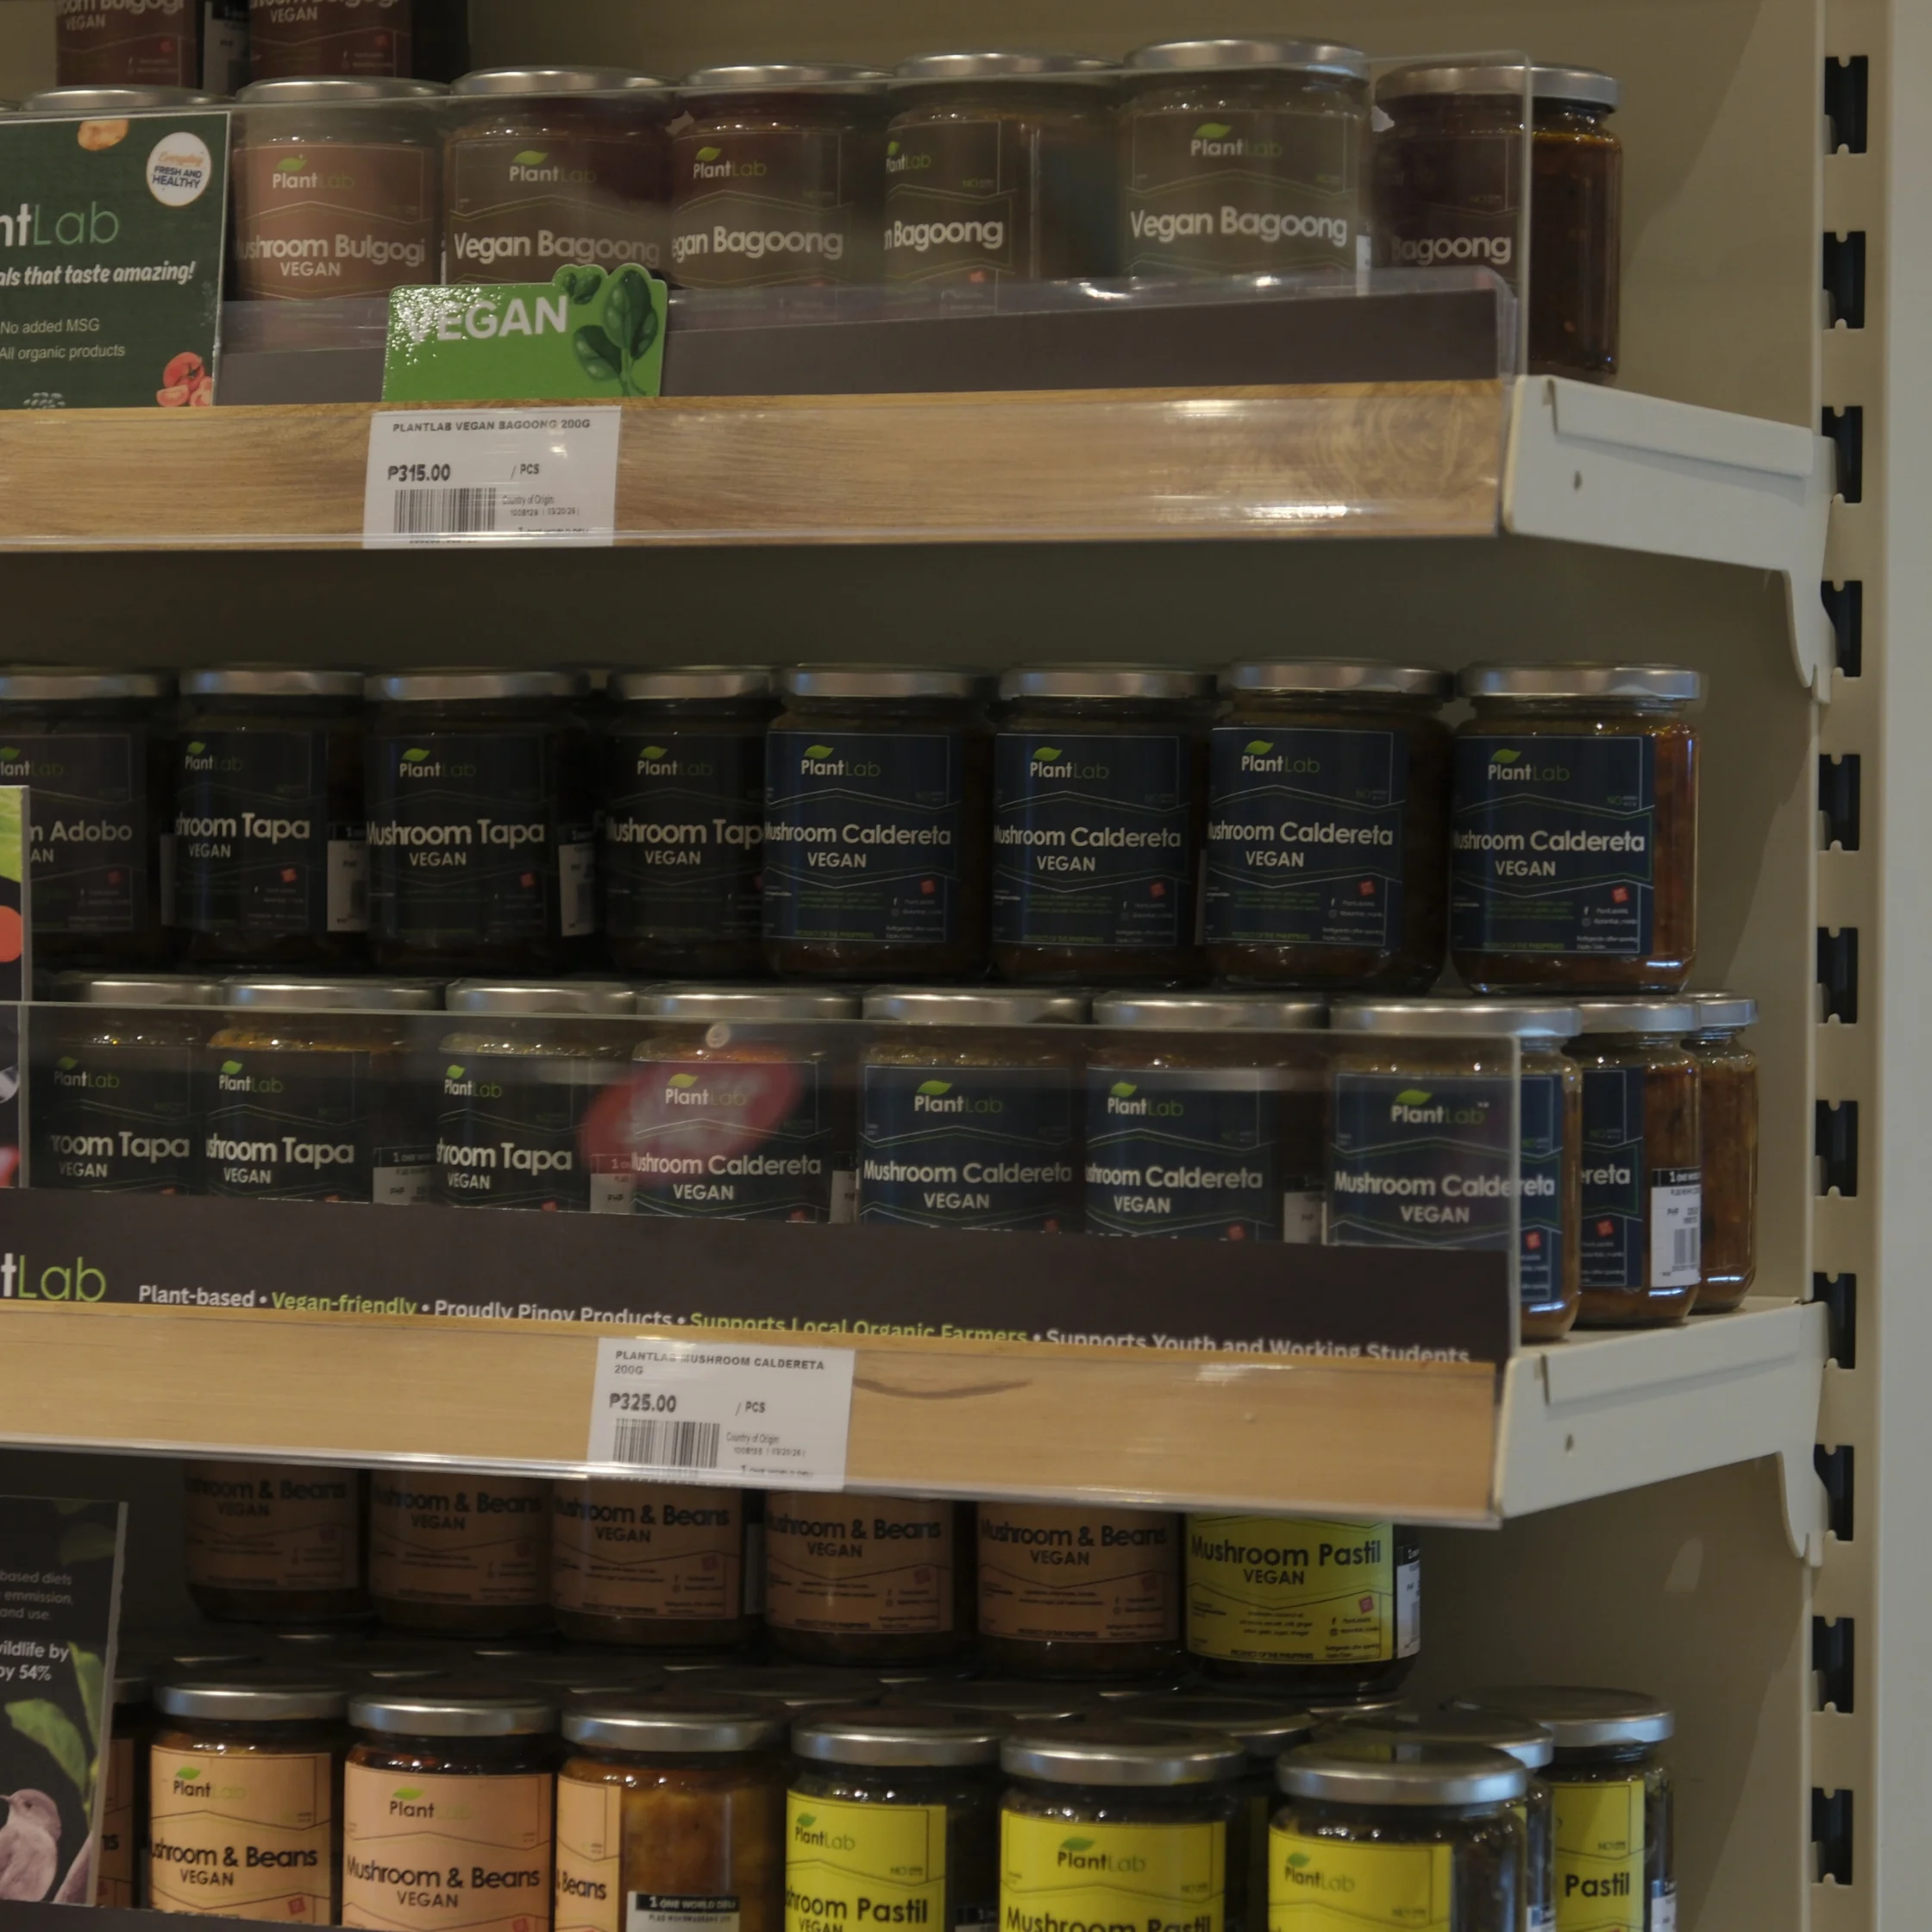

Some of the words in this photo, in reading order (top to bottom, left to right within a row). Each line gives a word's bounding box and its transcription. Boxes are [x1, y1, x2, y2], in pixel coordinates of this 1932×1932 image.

[66, 15, 105, 30] VEGAN
[270, 7, 317, 23] VEGAN
[1191, 139, 1282, 156] PlantLab
[154, 166, 181, 176] FRESH
[183, 169, 203, 179] AND
[510, 166, 597, 183] PlantLab
[693, 160, 767, 179] PlantLab
[153, 175, 200, 188] HEALTHY
[273, 172, 354, 189] PlantLab
[894, 220, 1004, 252] Bagoong
[1130, 210, 1213, 243] Vegan
[1220, 206, 1347, 247] Bagoong
[335, 234, 425, 267] Bulgogi
[454, 232, 530, 264] Vegan
[537, 229, 659, 267] Bagoong
[713, 225, 844, 260] Bagoong
[24, 265, 62, 285] that
[65, 263, 110, 284] taste
[113, 261, 196, 285] amazing!
[280, 261, 341, 277] VEGAN
[1, 321, 19, 335] No
[22, 319, 62, 334] added
[66, 317, 100, 333] MSG
[398, 295, 569, 342] VEGAN
[18, 346, 66, 362] organic
[69, 343, 126, 360] products
[392, 422, 452, 433] PLANTLAB
[455, 421, 494, 431] VEGAN
[499, 419, 557, 430] BAGOONG
[561, 418, 591, 430] 200G
[520, 463, 540, 475] PCS
[185, 755, 243, 772] PlantLab
[399, 762, 477, 777] PlantLab
[637, 760, 713, 776] PlantLab
[800, 759, 881, 777] PlantLab
[1029, 761, 1109, 780] PlantLab
[1241, 756, 1320, 775] PlantLab
[1488, 763, 1570, 782] PlantLab
[49, 819, 133, 843] Adobo
[241, 812, 310, 844] Tapa
[366, 820, 472, 846] Mushroom
[476, 819, 545, 850] Tapa
[712, 819, 764, 851] Tap
[841, 823, 952, 845] Caldereta
[1070, 826, 1182, 849] Caldereta
[1279, 820, 1393, 846] Caldereta
[188, 843, 231, 858] VEGAN
[1529, 830, 1646, 853] Caldereta
[409, 851, 467, 867] VEGAN
[644, 850, 701, 865] VEGAN
[806, 851, 867, 869] VEGAN
[1037, 855, 1096, 873] VEGAN
[1245, 850, 1304, 868] VEGAN
[1495, 860, 1556, 876] VEGAN
[53, 1070, 121, 1089] PlantLab
[218, 1075, 284, 1094] PlantLab
[444, 1079, 503, 1099] PlantLab
[664, 1088, 748, 1107] PlantLab
[913, 1095, 1003, 1113] PlantLab
[1107, 1096, 1184, 1117] PlantLab
[1390, 1104, 1486, 1125] PlantLab
[118, 1131, 191, 1164] Tapa
[281, 1137, 354, 1170] Tapa
[500, 1142, 573, 1176] Tapa
[707, 1154, 822, 1176] Caldereta
[59, 1161, 109, 1178] VEGAN
[223, 1167, 272, 1184] VEGAN
[863, 1159, 957, 1182] Mushroom
[962, 1161, 1072, 1184] Caldereta
[1145, 1165, 1263, 1189] Caldereta
[447, 1172, 491, 1189] VEGAN
[1334, 1170, 1435, 1196] Mushroom
[673, 1183, 735, 1201] VEGAN
[923, 1193, 990, 1209] VEGAN
[1113, 1195, 1171, 1214] VEGAN
[1400, 1207, 1470, 1223] VEGAN
[138, 1284, 256, 1307] Plant-based
[271, 1291, 417, 1315] Vegan-friendly
[434, 1299, 513, 1319] Proudly
[580, 1306, 673, 1326] Products
[792, 1317, 848, 1335] Local
[1151, 1333, 1216, 1352] Youth
[1222, 1336, 1264, 1354] and
[1269, 1339, 1361, 1358] Working
[1366, 1343, 1471, 1363] Students
[614, 1364, 643, 1375] 200G
[615, 1350, 676, 1363] PLANTLAB
[681, 1353, 750, 1366] MUSHROOM
[754, 1357, 825, 1371] CALDERETA
[745, 1402, 766, 1414] PCS
[259, 1479, 273, 1499] &
[279, 1479, 347, 1500] Beans
[217, 1502, 270, 1517] VEGAN
[455, 1491, 470, 1514] &
[476, 1492, 543, 1515] Beans
[411, 1515, 466, 1531] VEGAN
[640, 1503, 656, 1525] &
[662, 1504, 731, 1527] Beans
[594, 1527, 651, 1543] VEGAN
[851, 1518, 868, 1540] &
[874, 1519, 942, 1541] Beans
[1077, 1525, 1095, 1547] &
[1101, 1525, 1167, 1546] Beans
[806, 1541, 862, 1559] VEGAN
[1029, 1550, 1089, 1566] VEGAN
[1191, 1534, 1309, 1566] Mushroom
[1318, 1539, 1381, 1566] Pastil
[41, 1571, 72, 1585] diets
[1243, 1568, 1304, 1585] VEGAN
[28, 1609, 52, 1622] use.
[49, 1643, 70, 1663] by
[18, 1664, 52, 1682] 54%
[794, 1825, 856, 1852] PlantLab
[223, 1847, 238, 1867] &
[246, 1847, 318, 1867] Beans
[1057, 1850, 1147, 1873] PlantLab
[179, 1868, 234, 1886] VEGAN
[347, 1860, 442, 1887] Mushroom
[447, 1868, 465, 1889] &
[471, 1867, 540, 1888] Beans
[1284, 1866, 1356, 1893] PlantLab
[561, 1878, 607, 1900] Beans
[1565, 1872, 1630, 1898] Pastil
[397, 1891, 459, 1908] VEGAN
[649, 1896, 657, 1908] 1
[659, 1898, 680, 1909] ONE
[681, 1899, 715, 1910] WORLD
[856, 1898, 928, 1924] Pastil
